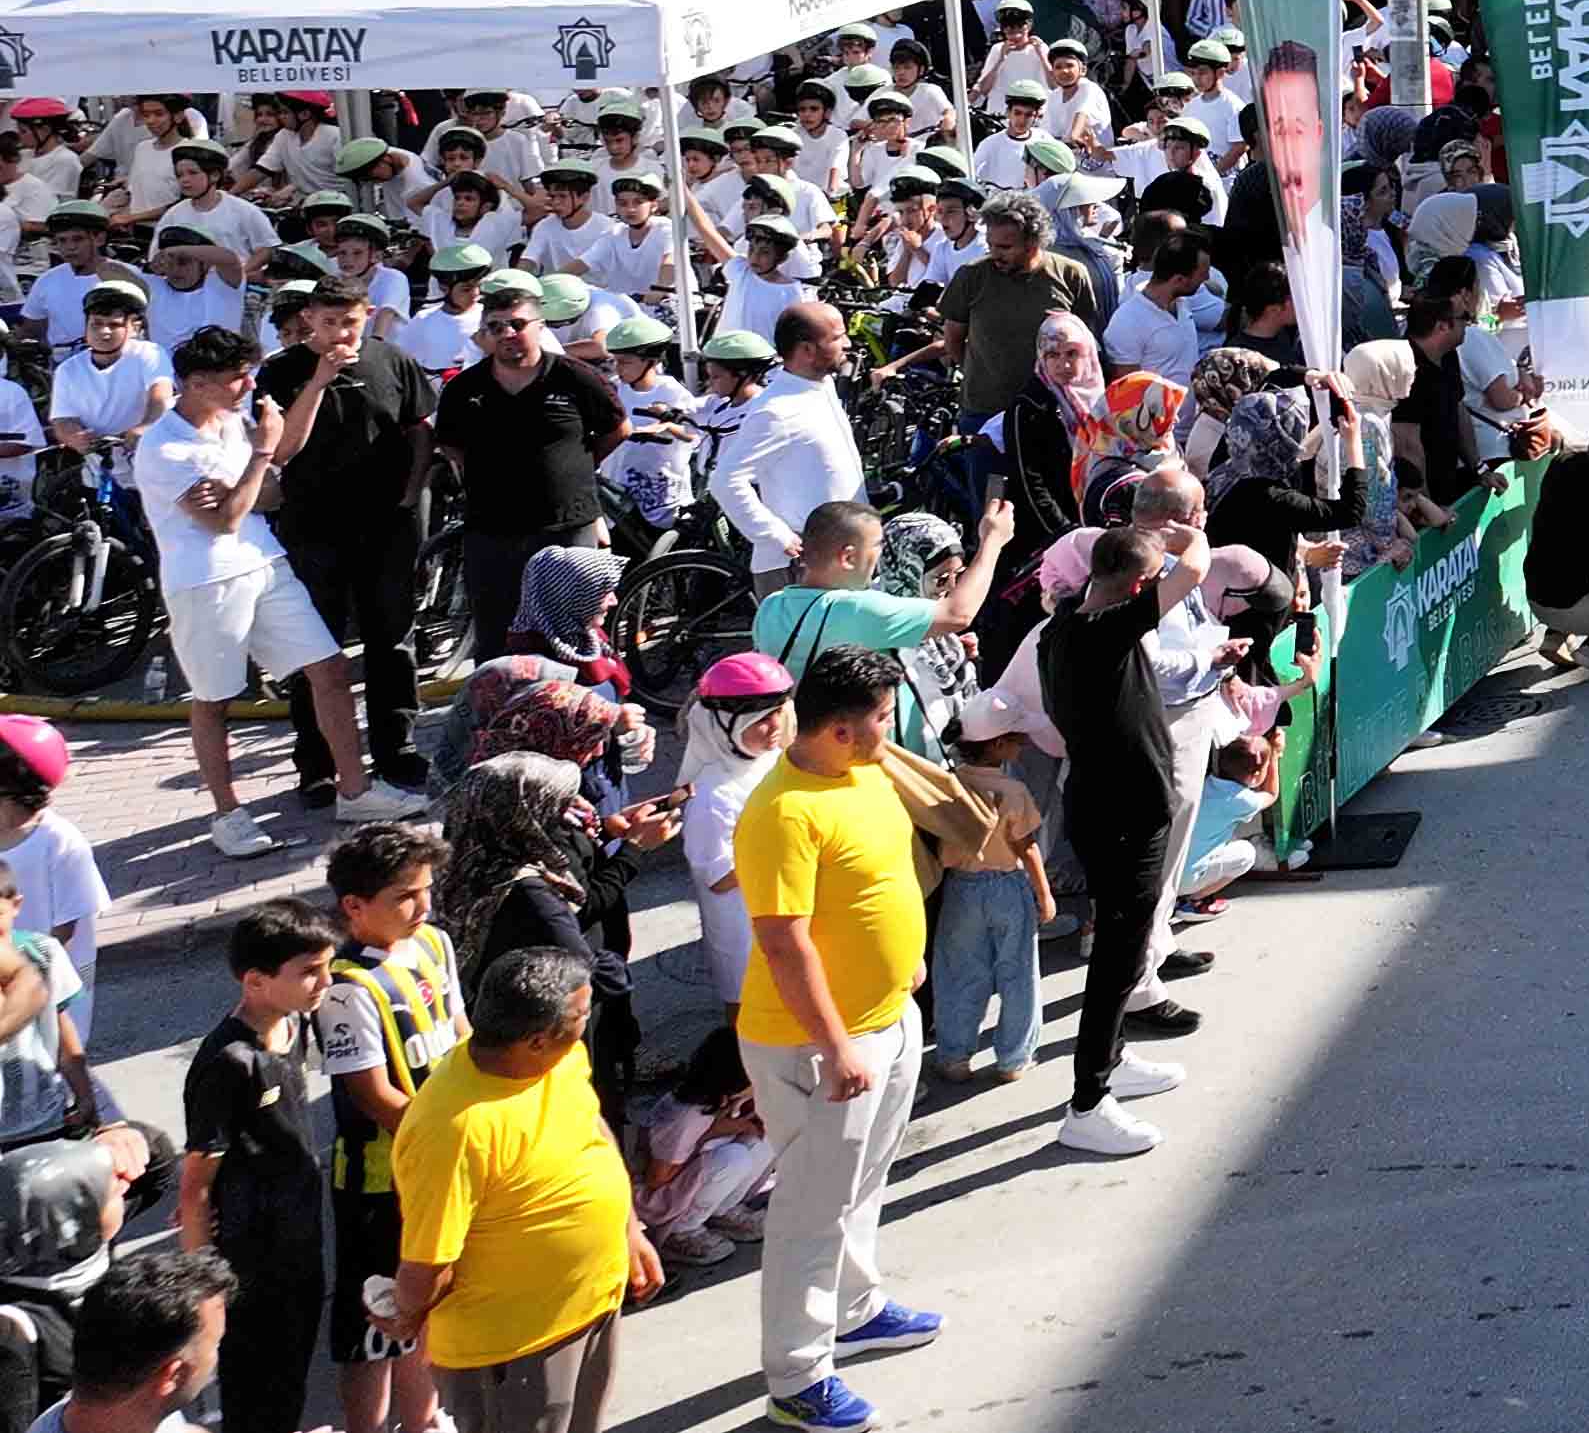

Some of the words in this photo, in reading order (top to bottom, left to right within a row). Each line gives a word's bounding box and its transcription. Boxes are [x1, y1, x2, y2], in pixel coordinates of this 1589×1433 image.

[211, 27, 367, 66] KARATAY
[238, 65, 351, 84] BELEDİYESİ
[1415, 532, 1480, 618] KARATAY
[327, 1046, 360, 1059] PORT
